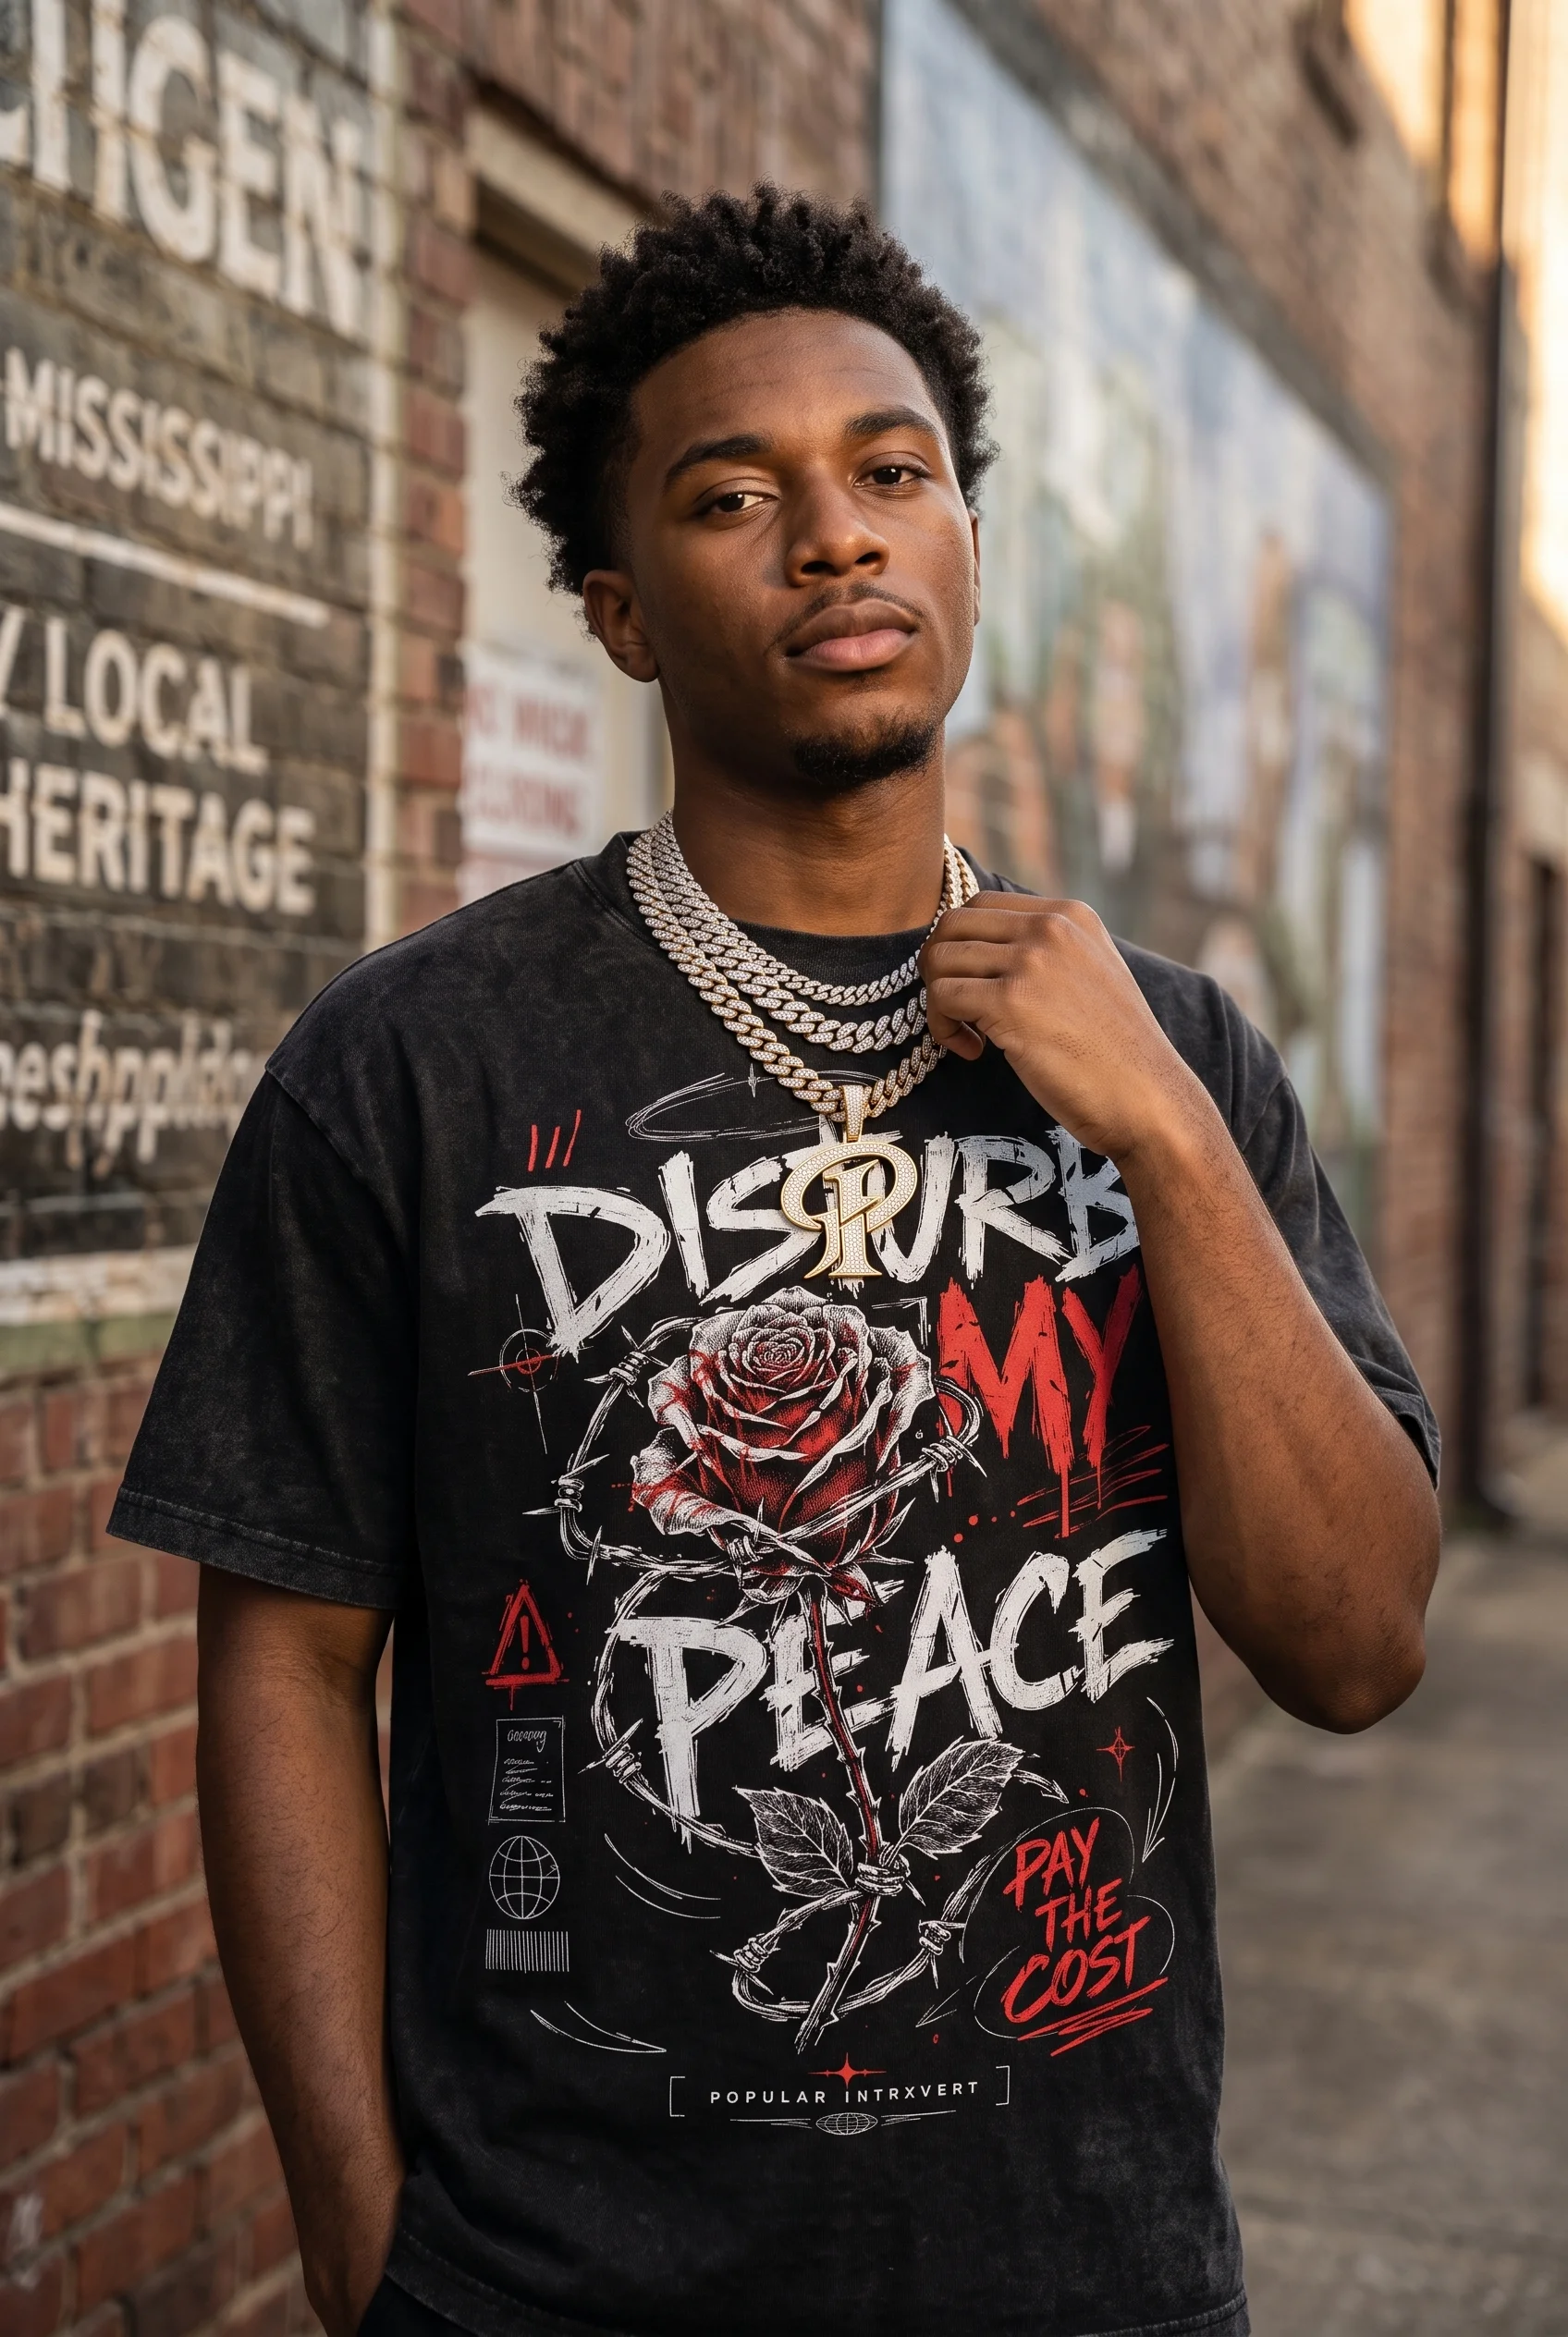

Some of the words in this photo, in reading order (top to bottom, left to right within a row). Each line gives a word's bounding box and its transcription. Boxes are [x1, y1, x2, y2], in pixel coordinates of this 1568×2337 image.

[45, 616, 269, 777] LOCAL
[0, 756, 317, 917] HERITAGE
[936, 1265, 1144, 1488] MY
[606, 1528, 1175, 1854] PEACE
[1003, 1816, 1100, 1913] PAY
[1035, 1878, 1122, 1952] THE
[1000, 1915, 1152, 2024] COST
[710, 2090, 827, 2105] POPULAR
[845, 2081, 979, 2104] INTRXVERT
